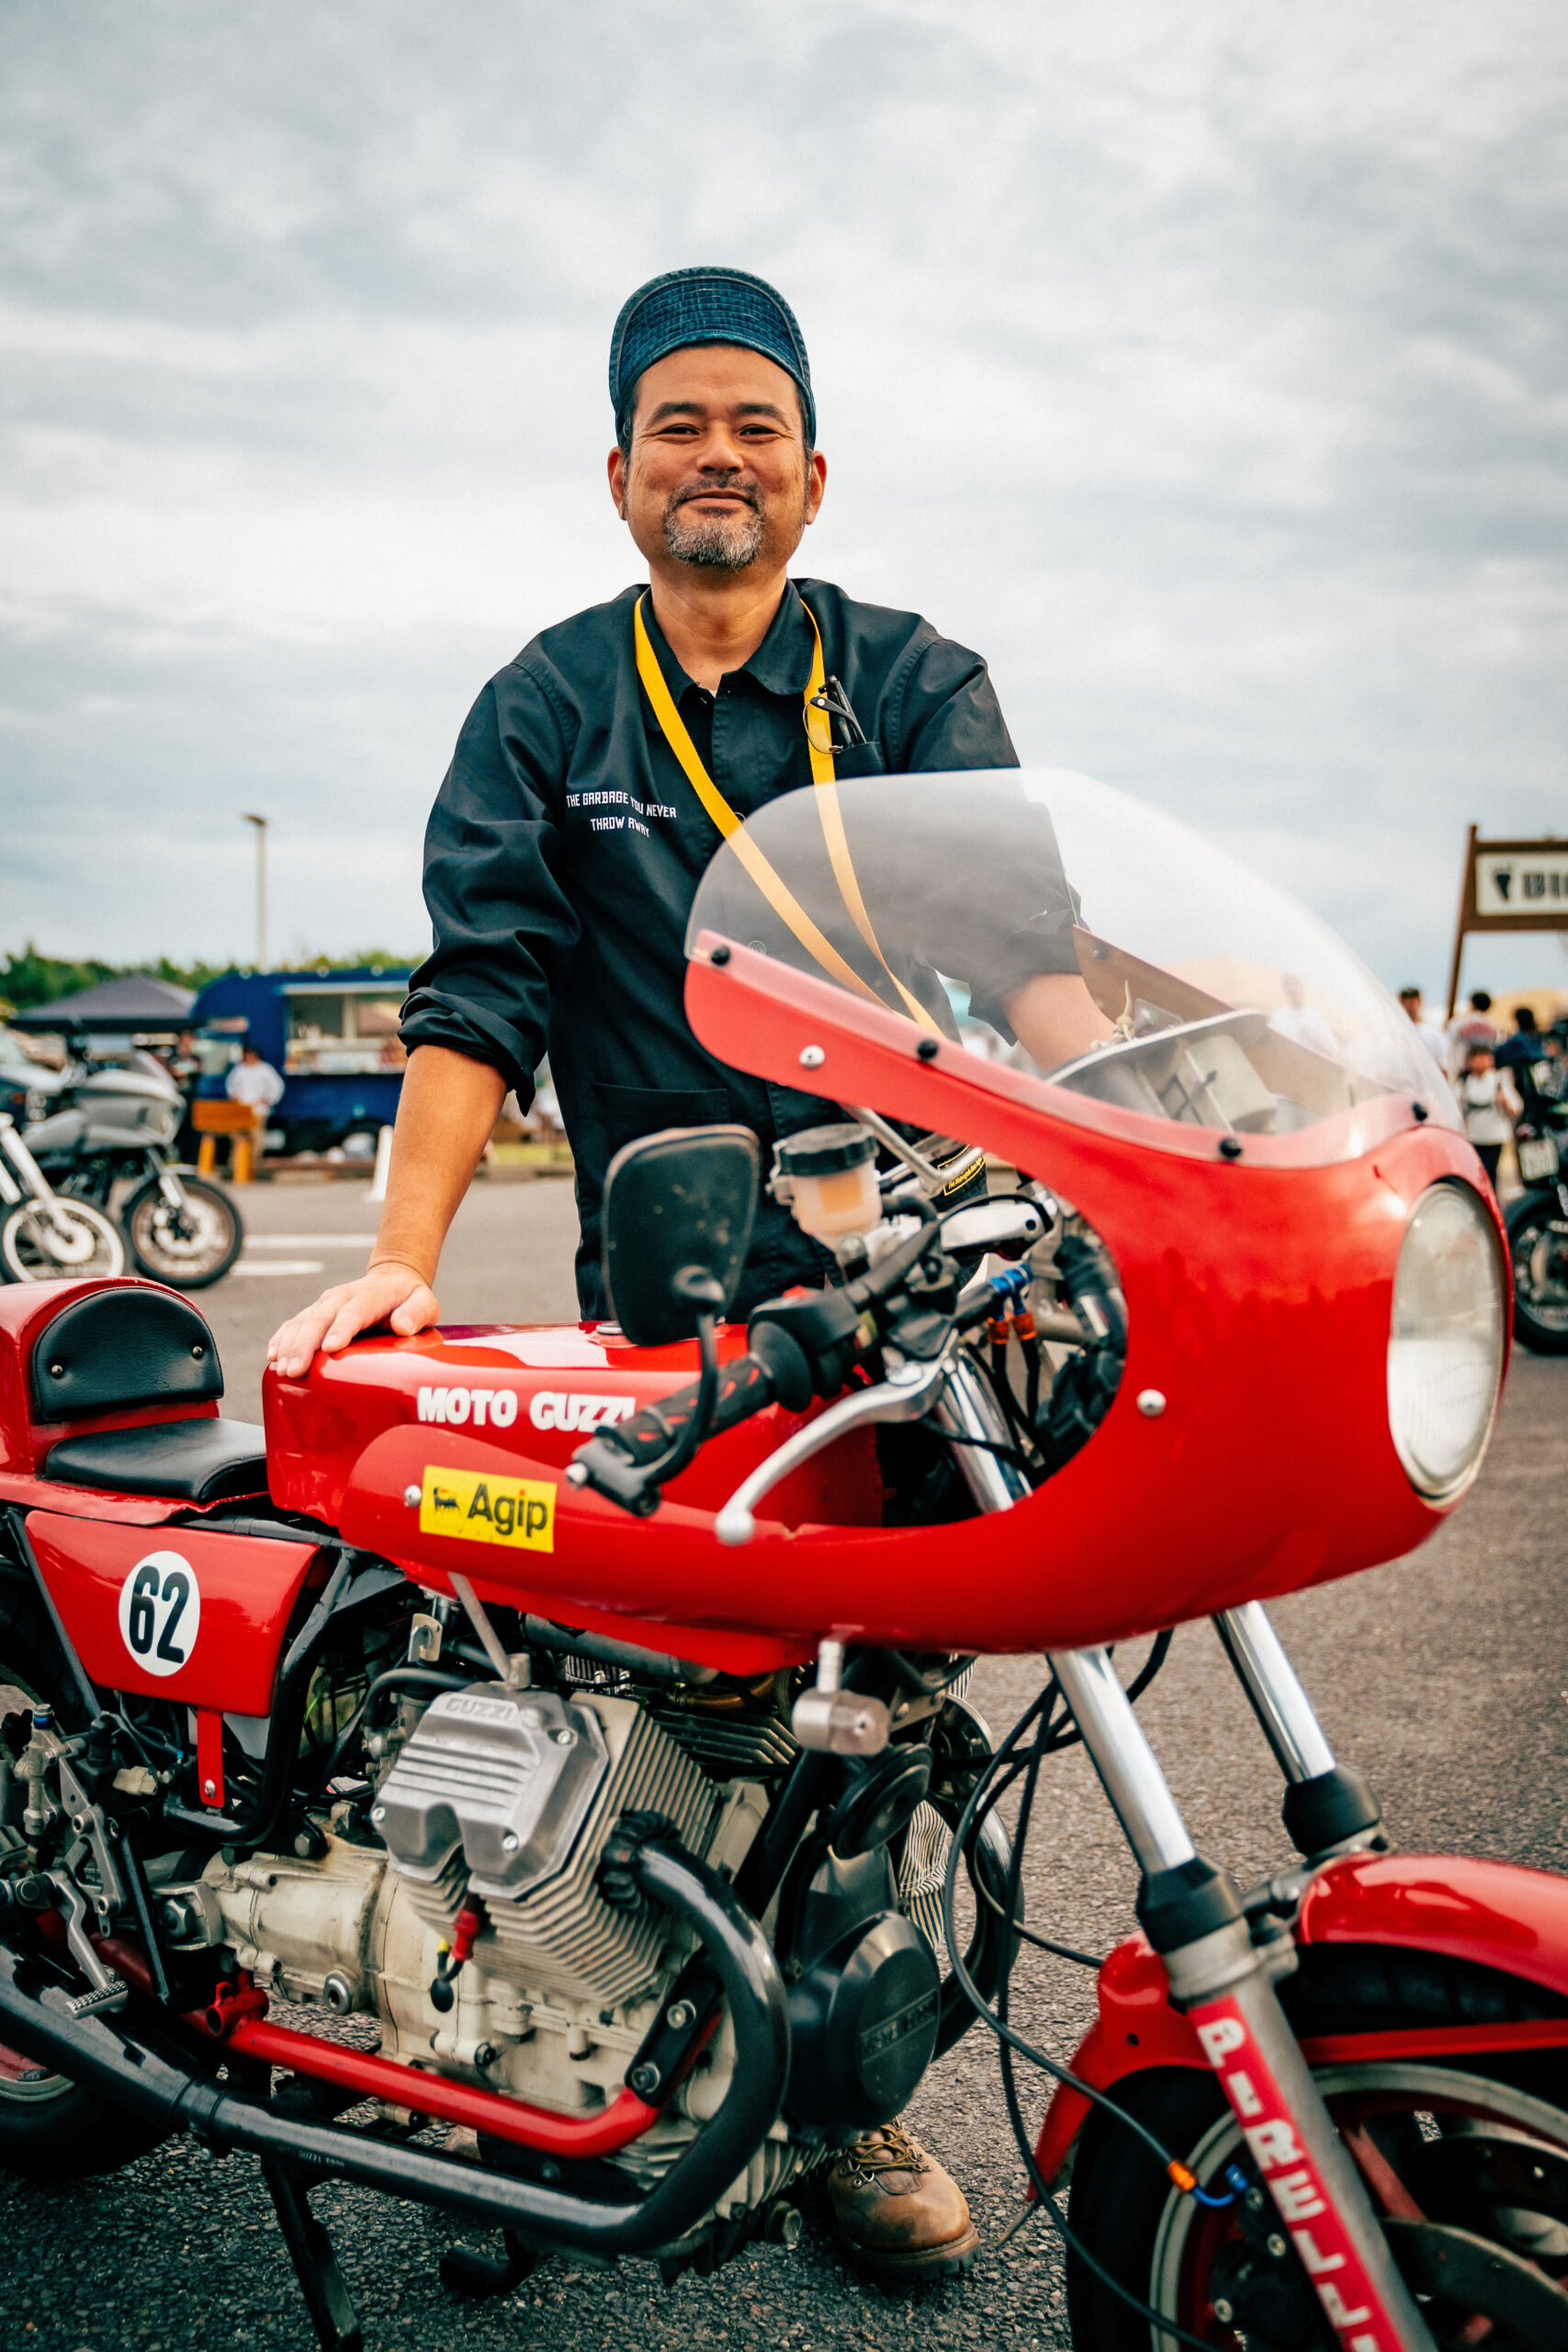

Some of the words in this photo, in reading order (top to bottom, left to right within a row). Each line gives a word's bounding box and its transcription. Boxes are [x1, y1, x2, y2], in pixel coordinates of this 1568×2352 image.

[566, 793, 581, 808] THE
[582, 790, 629, 806] GARBAGE
[629, 795, 644, 815] YOU
[646, 803, 677, 818] NEVER
[590, 816, 626, 831] THROW
[627, 816, 650, 838] AWAY
[417, 1385, 518, 1428] MOTO
[468, 1482, 548, 1539] Agip
[129, 1565, 190, 1664] 62
[445, 1697, 513, 1721] GUZZI
